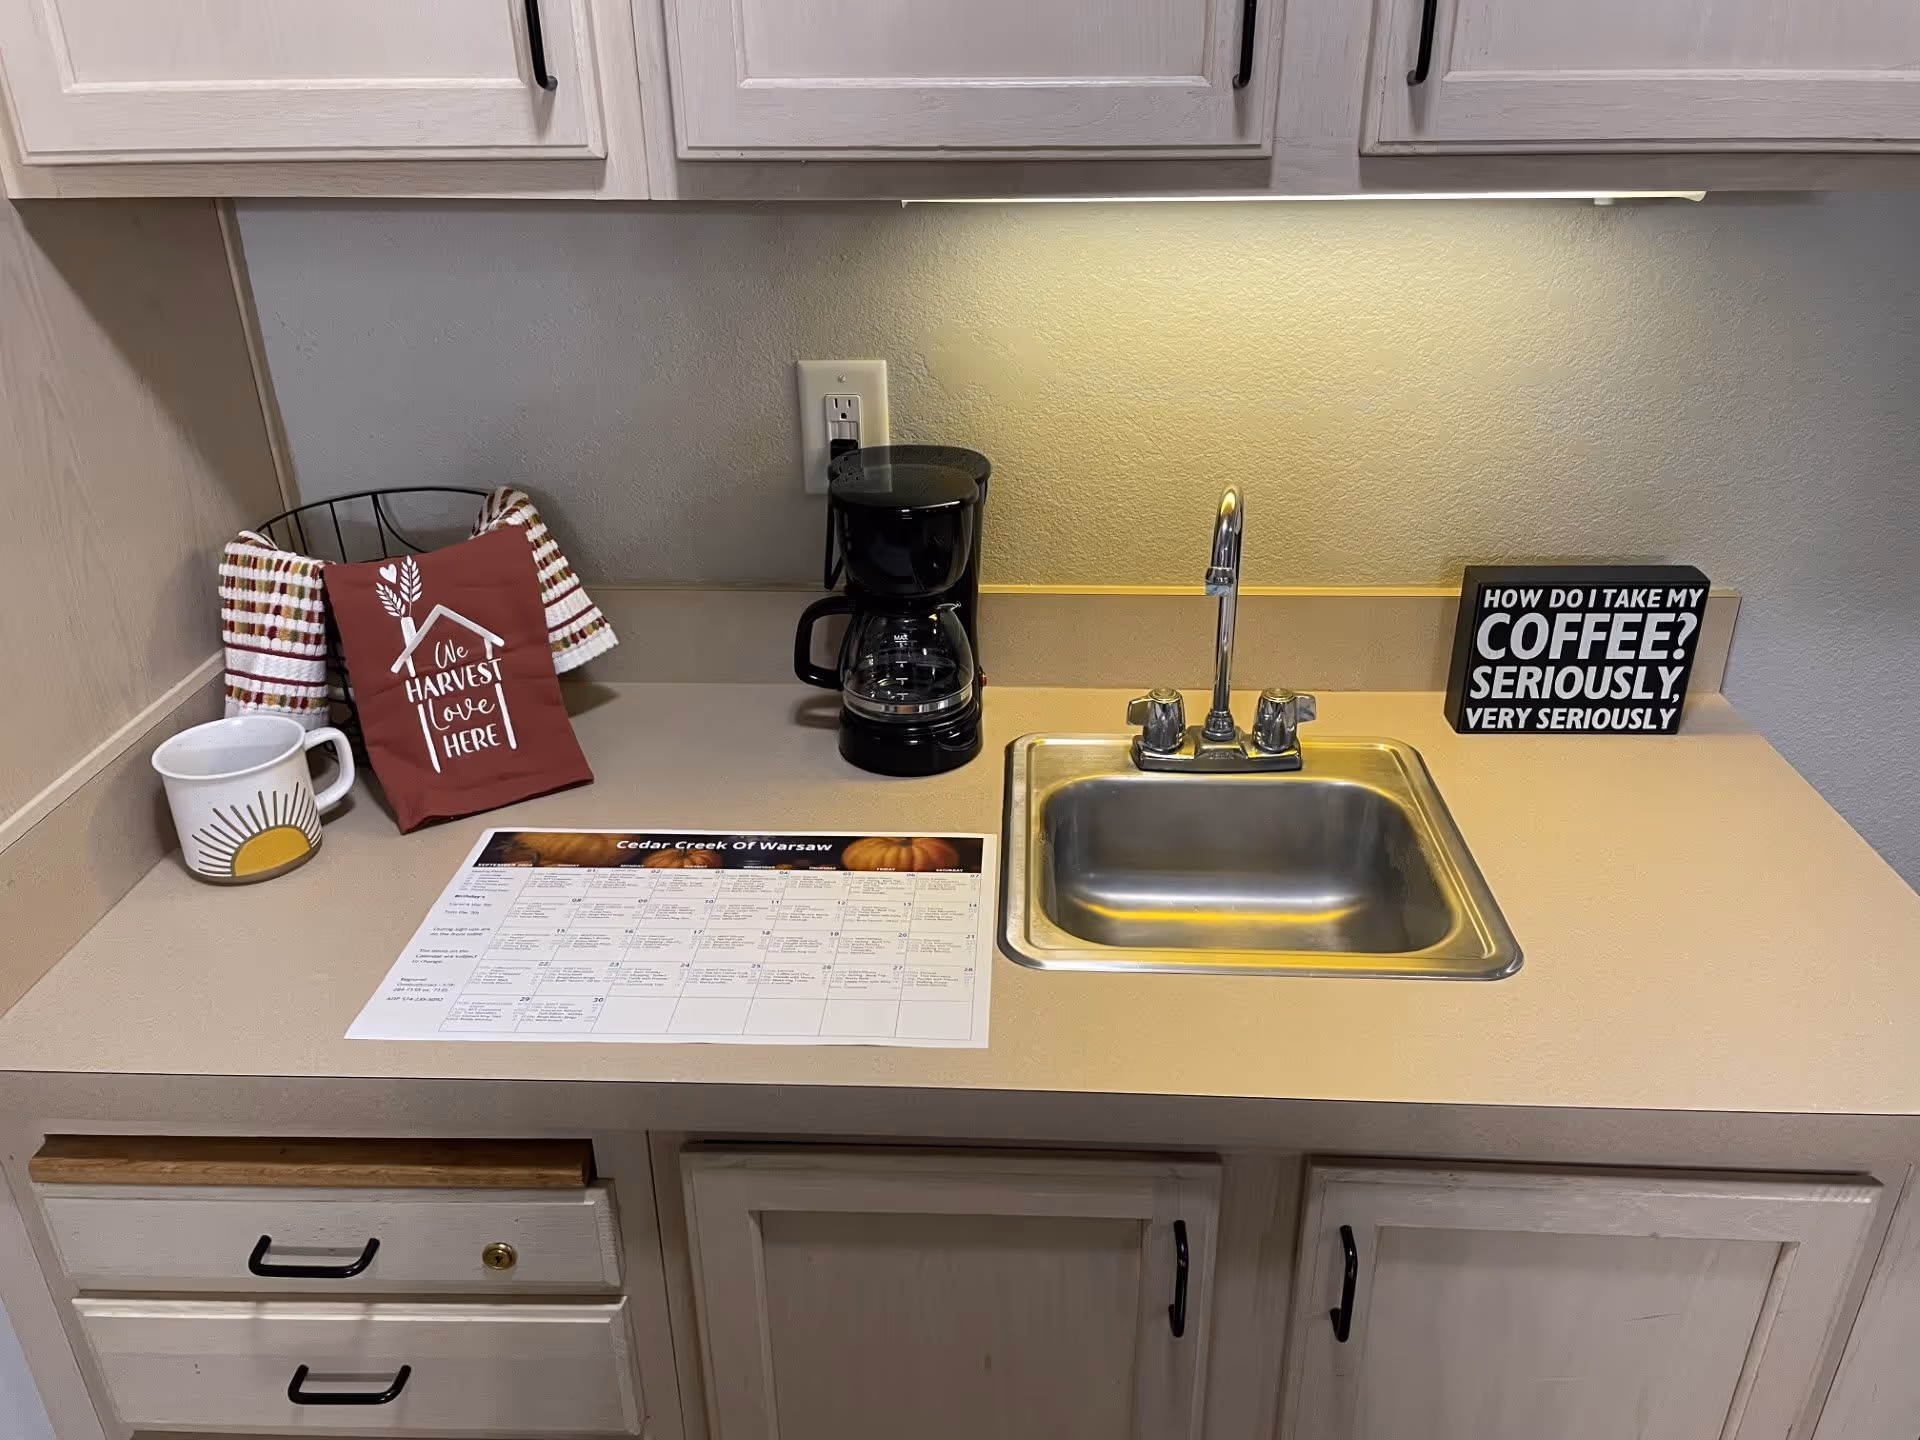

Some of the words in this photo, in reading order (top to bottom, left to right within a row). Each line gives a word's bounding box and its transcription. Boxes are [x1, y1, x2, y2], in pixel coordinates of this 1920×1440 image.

[1484, 588, 1543, 608] HOW
[1549, 588, 1584, 608] DO
[1588, 589, 1597, 608] I
[1603, 588, 1662, 608] TAKE
[1666, 588, 1704, 608] MY
[1476, 612, 1698, 660] COFFEE?
[435, 638, 468, 669] We
[405, 658, 502, 703] HARVEST
[1469, 666, 1684, 704] SERIOUSLY,
[428, 697, 496, 731] Love
[1466, 708, 1532, 729] VERY
[1536, 707, 1677, 730] SERIOUSLY
[443, 723, 501, 758] HERE
[616, 840, 670, 850] Cedar
[675, 840, 728, 850] Creek
[732, 841, 757, 850] Of
[760, 842, 832, 851] Warsaw
